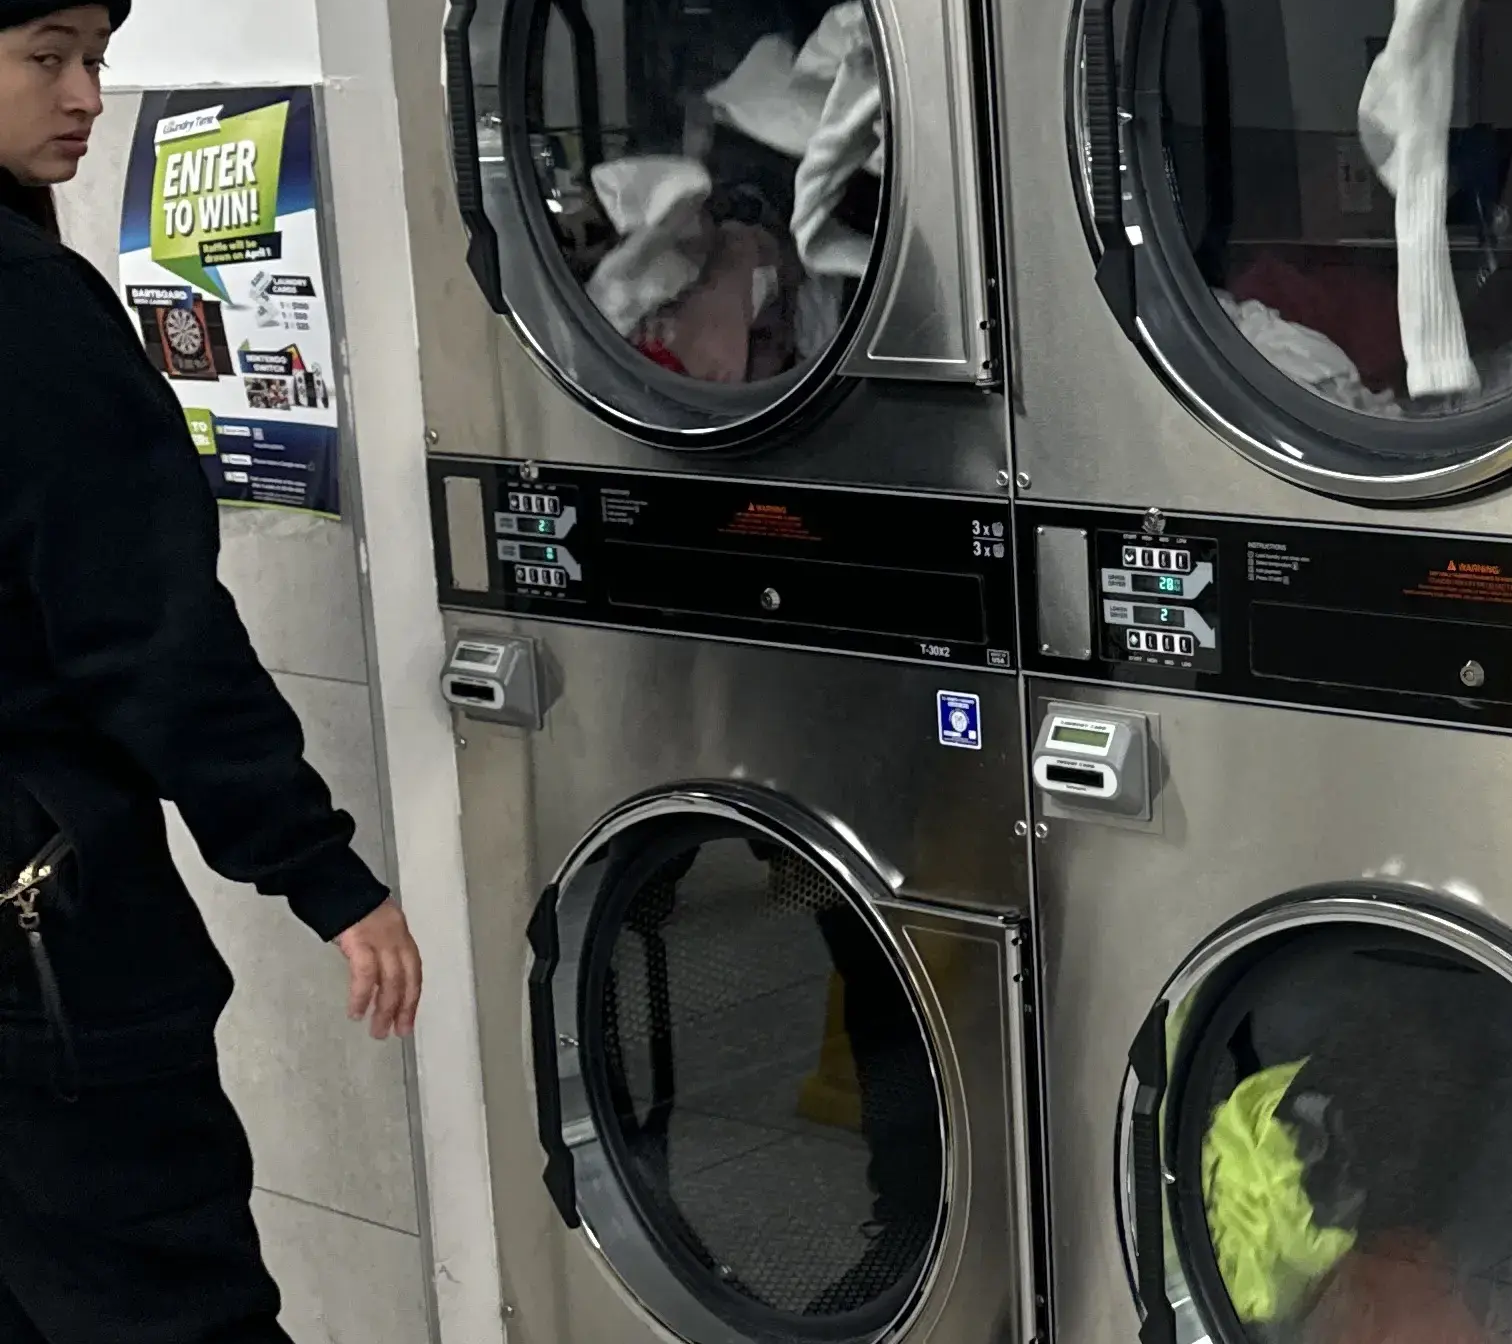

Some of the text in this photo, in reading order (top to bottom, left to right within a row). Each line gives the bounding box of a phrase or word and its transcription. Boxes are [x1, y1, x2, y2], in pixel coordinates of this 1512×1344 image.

[162, 114, 214, 135] Laundry Time
[163, 139, 257, 199] ENTER
[162, 188, 260, 237] TO WIN!
[247, 239, 257, 249] be
[971, 519, 981, 536] 3
[972, 540, 982, 557] 3
[1159, 576, 1174, 591] 28
[1160, 607, 1168, 622] 2
[919, 642, 951, 658] T-30X2
